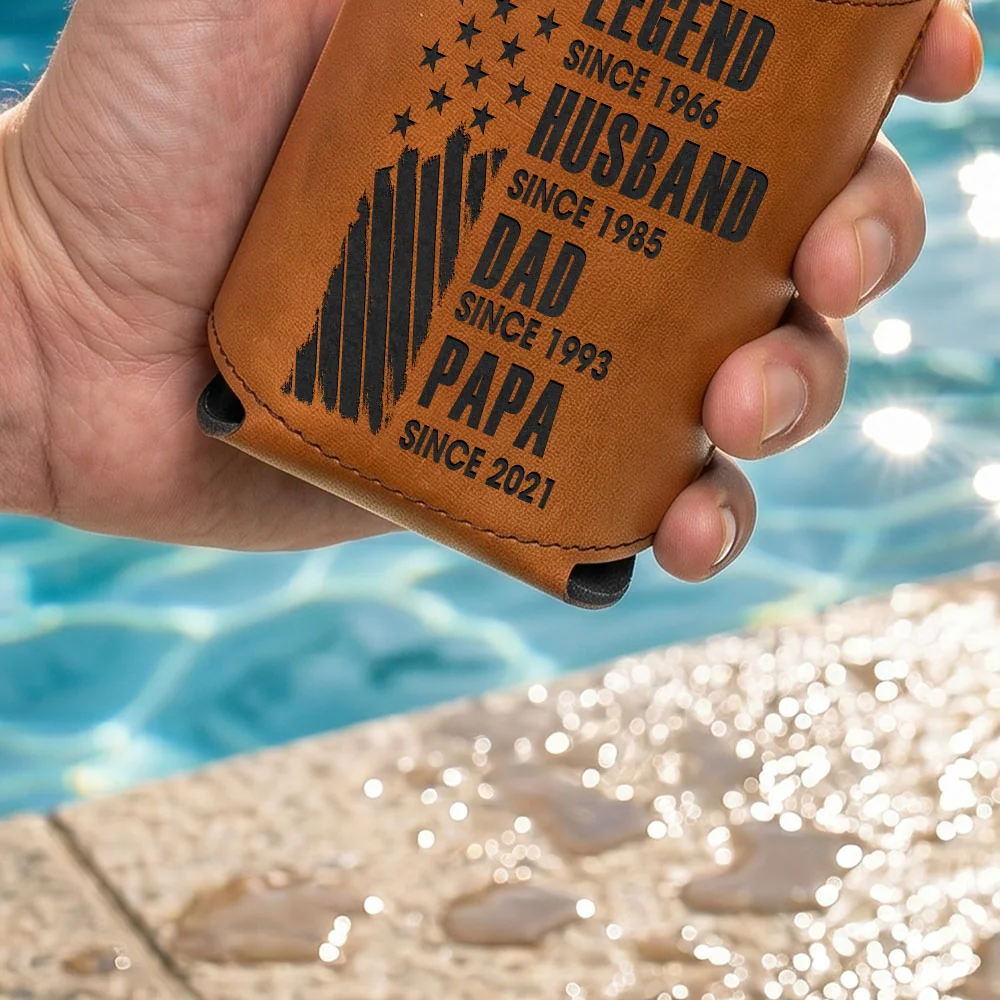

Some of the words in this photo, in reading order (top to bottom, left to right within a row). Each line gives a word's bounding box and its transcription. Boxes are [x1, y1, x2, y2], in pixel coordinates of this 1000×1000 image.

[562, 39, 652, 100] SINCE
[653, 76, 722, 130] 1966
[525, 82, 769, 243] HUSBAND
[506, 168, 595, 230] SINCE
[597, 205, 667, 260] 1985
[469, 212, 587, 318] DAD
[454, 290, 543, 352] SINCE
[545, 327, 613, 382] 1993
[417, 334, 565, 459] PAPA
[398, 419, 487, 480] SINCE
[484, 456, 556, 510] 2021
